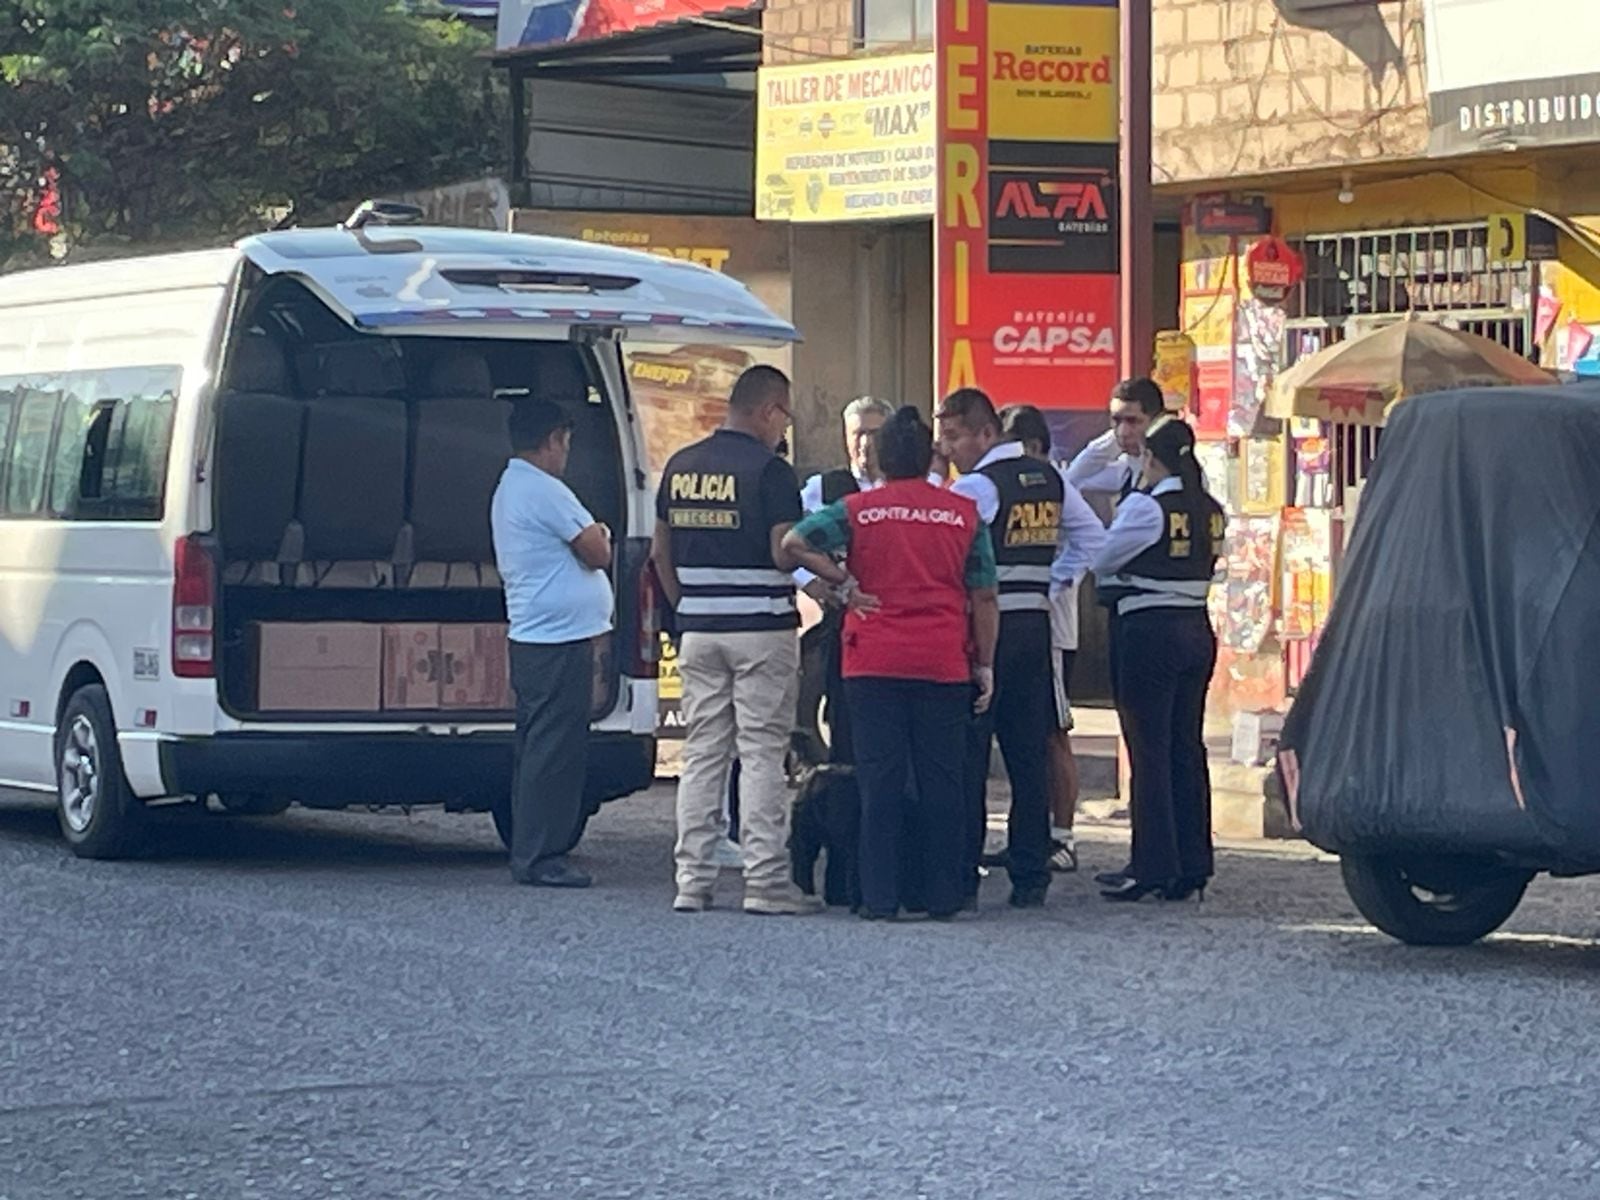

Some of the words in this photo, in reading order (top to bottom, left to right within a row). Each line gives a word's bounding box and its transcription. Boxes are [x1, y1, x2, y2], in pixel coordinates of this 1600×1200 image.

[992, 51, 1112, 84] Record
[767, 76, 820, 107] TALLER
[824, 74, 845, 102] DE
[848, 64, 933, 99] MECANICO
[995, 181, 1109, 219] ALFA
[992, 326, 1115, 353] CAPSA
[671, 472, 735, 502] POLICIA
[857, 506, 966, 528] CONTRALORIA
